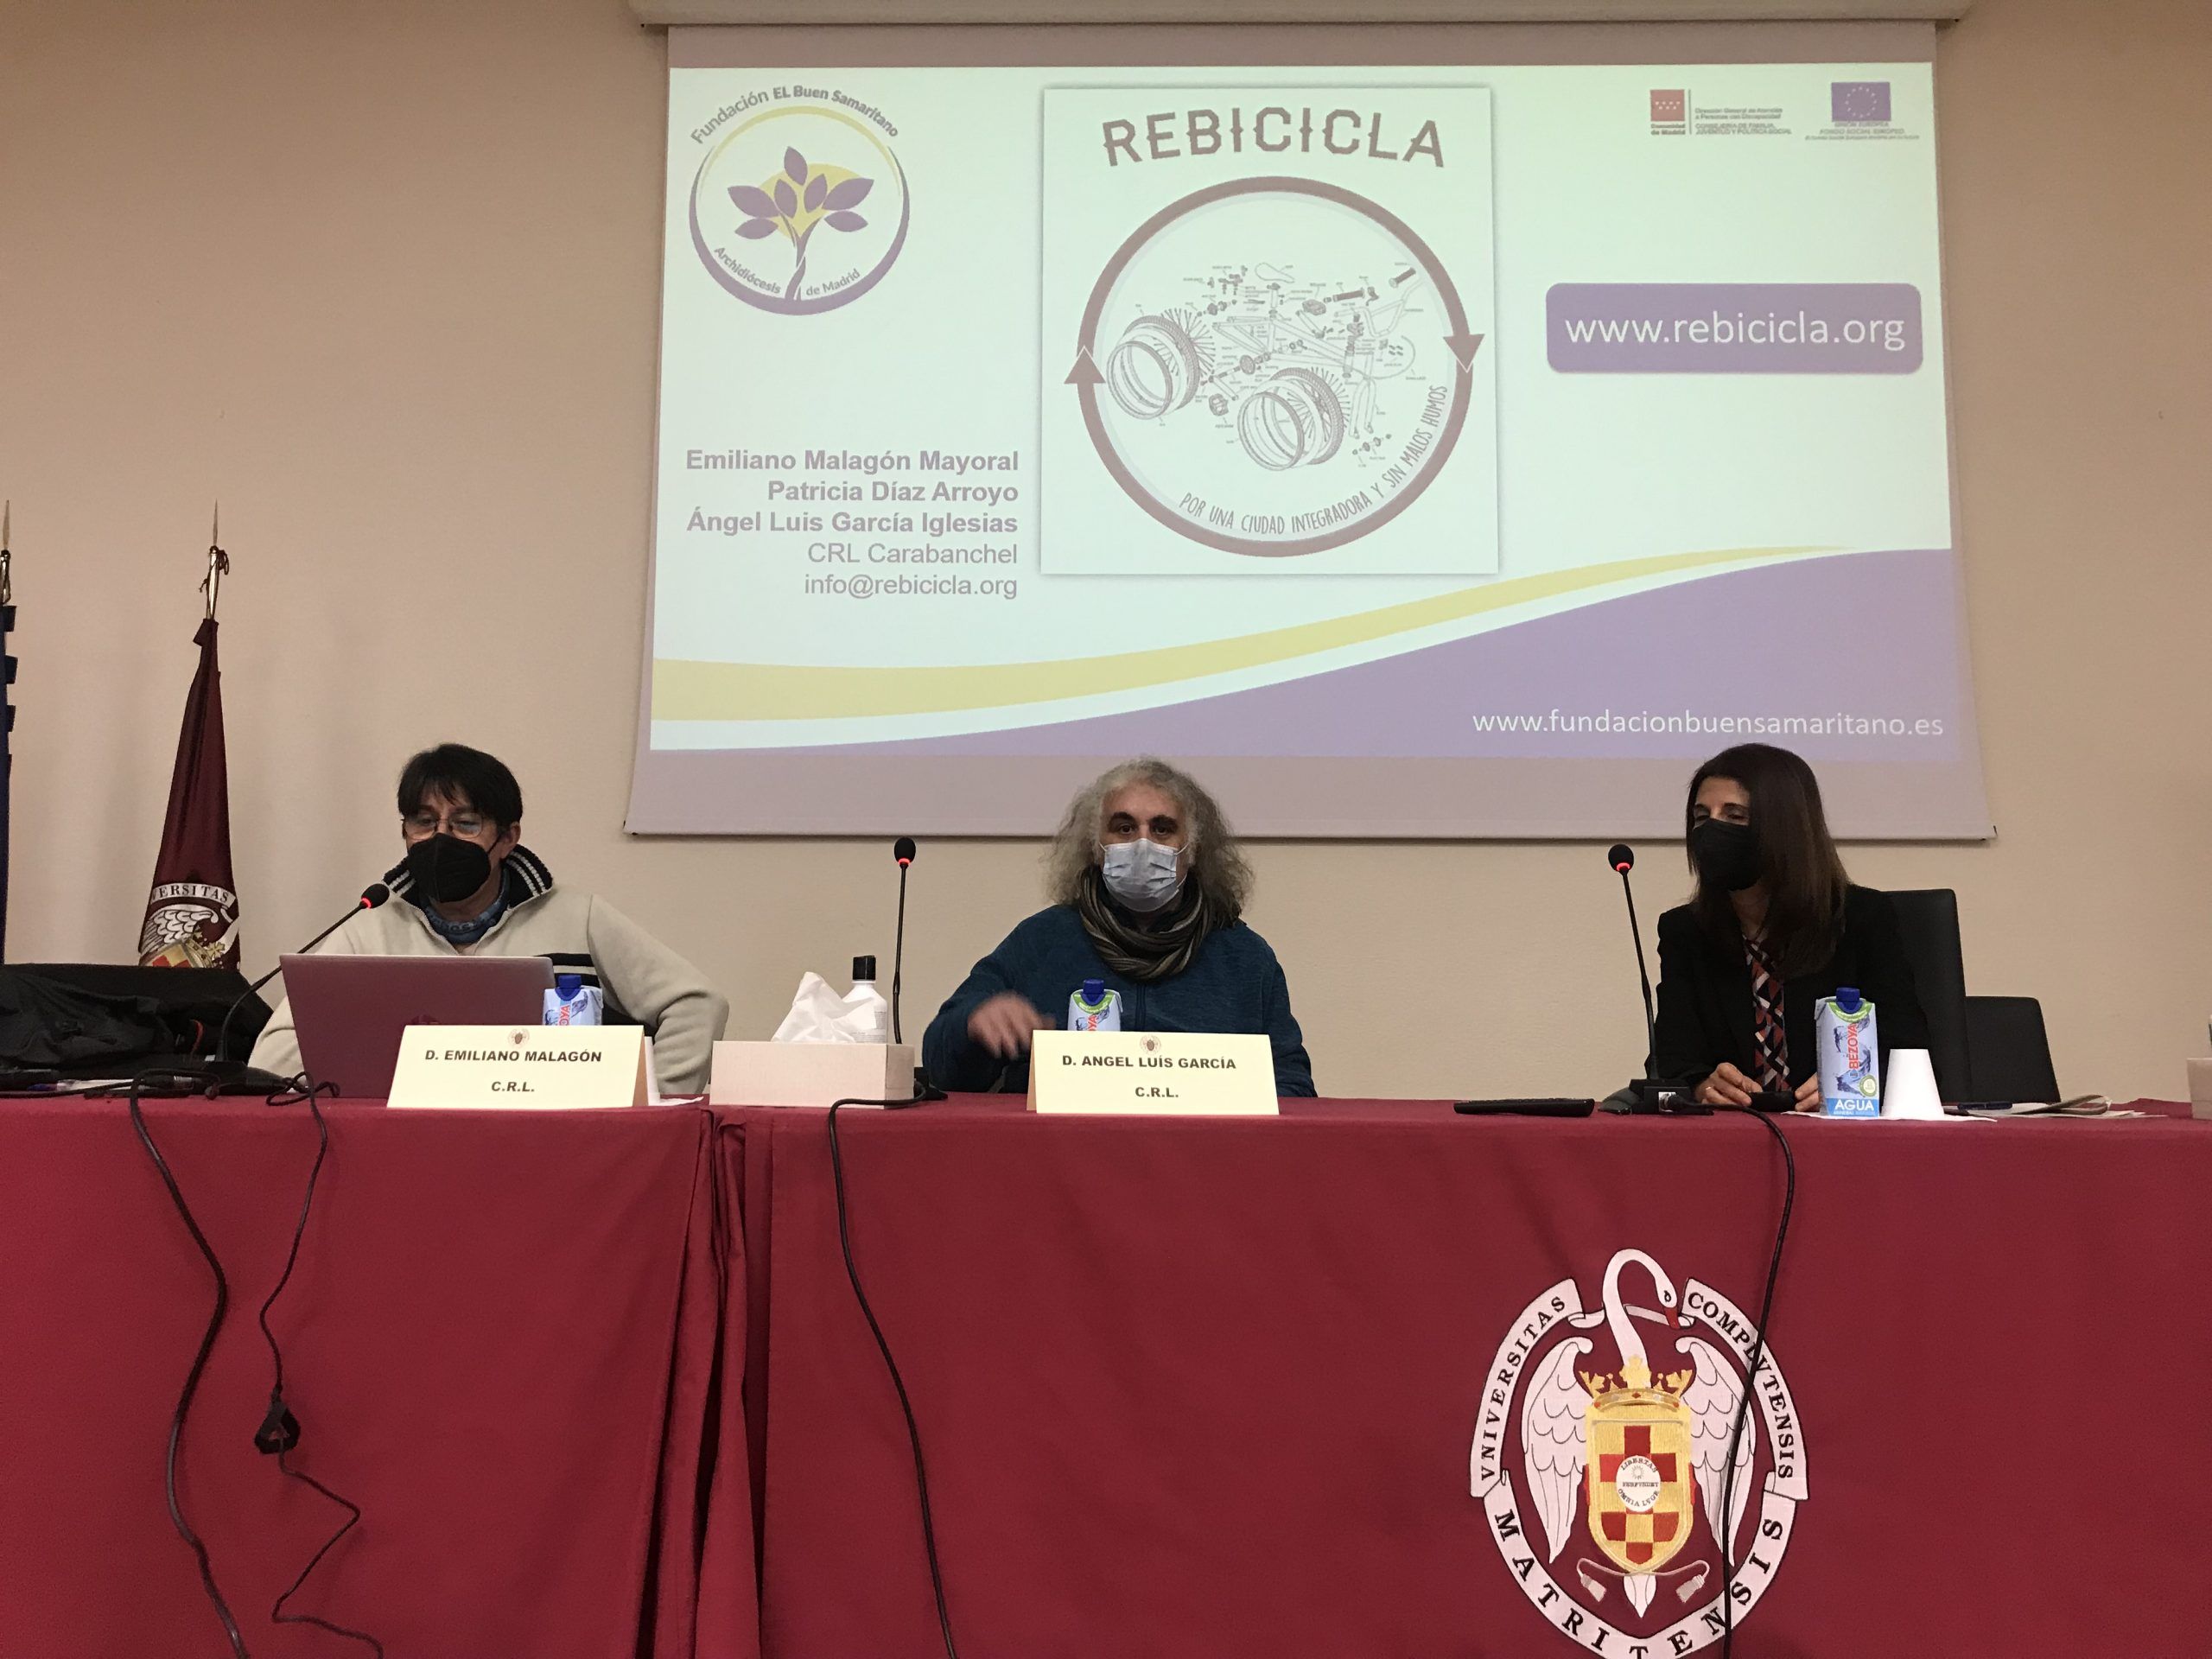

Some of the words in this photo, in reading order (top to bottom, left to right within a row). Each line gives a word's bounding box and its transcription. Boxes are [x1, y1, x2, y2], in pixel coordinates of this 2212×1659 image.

[690, 88, 769, 144] Fundación
[773, 86, 791, 100] EL
[793, 85, 830, 100] Buen
[831, 89, 899, 139] Samaritano
[1102, 106, 1445, 168] REBICICLA
[713, 245, 782, 296] Archidiócesis
[805, 283, 821, 296] de
[822, 268, 861, 293] Madrid
[1564, 310, 1905, 352] www.rebicicla.org
[686, 449, 797, 471] Emiliano
[804, 449, 911, 475] Malagón
[919, 450, 1020, 476] Mayoral
[1179, 492, 1208, 518] POR
[1209, 505, 1236, 530] UNA
[1241, 513, 1287, 535] CIUDAD
[1291, 490, 1373, 534] INTEGRADORA
[1370, 482, 1385, 499] Y
[1382, 463, 1408, 490] SIN
[1399, 428, 1433, 467] MALOS
[1420, 385, 1448, 428] HUMOS
[767, 480, 863, 501] Patricia
[871, 480, 925, 502] Díaz
[931, 481, 1020, 506] Arroyo
[686, 506, 761, 537] Ángel
[770, 512, 823, 531] Luis
[831, 512, 914, 532] García
[922, 512, 1019, 537] Iglesias
[807, 543, 861, 563] CRL
[868, 543, 1018, 563] Carabanchel
[804, 574, 1018, 600] info@rebicicla.org
[1472, 709, 1944, 736] www.fundacionbuensamaritano.es
[425, 1050, 439, 1061] D.
[444, 1050, 520, 1063] EMILIANO
[524, 1048, 602, 1063] MALAGÓN
[1847, 1023, 1859, 1070] BEZOYA
[1062, 1055, 1077, 1066] D.
[1081, 1055, 1134, 1067] ANGEL
[1138, 1054, 1173, 1069] LUÍS
[1178, 1055, 1236, 1070] GARCÍA
[491, 1081, 536, 1093] C.R.L.
[1135, 1087, 1179, 1098] C.R.L.
[1834, 1099, 1875, 1111] AGUA
[1481, 1295, 1567, 1482] VNIVERSITAS
[1687, 1291, 1795, 1480] COMPLVTENSIS
[1621, 1458, 1658, 1473] LIBERTAS
